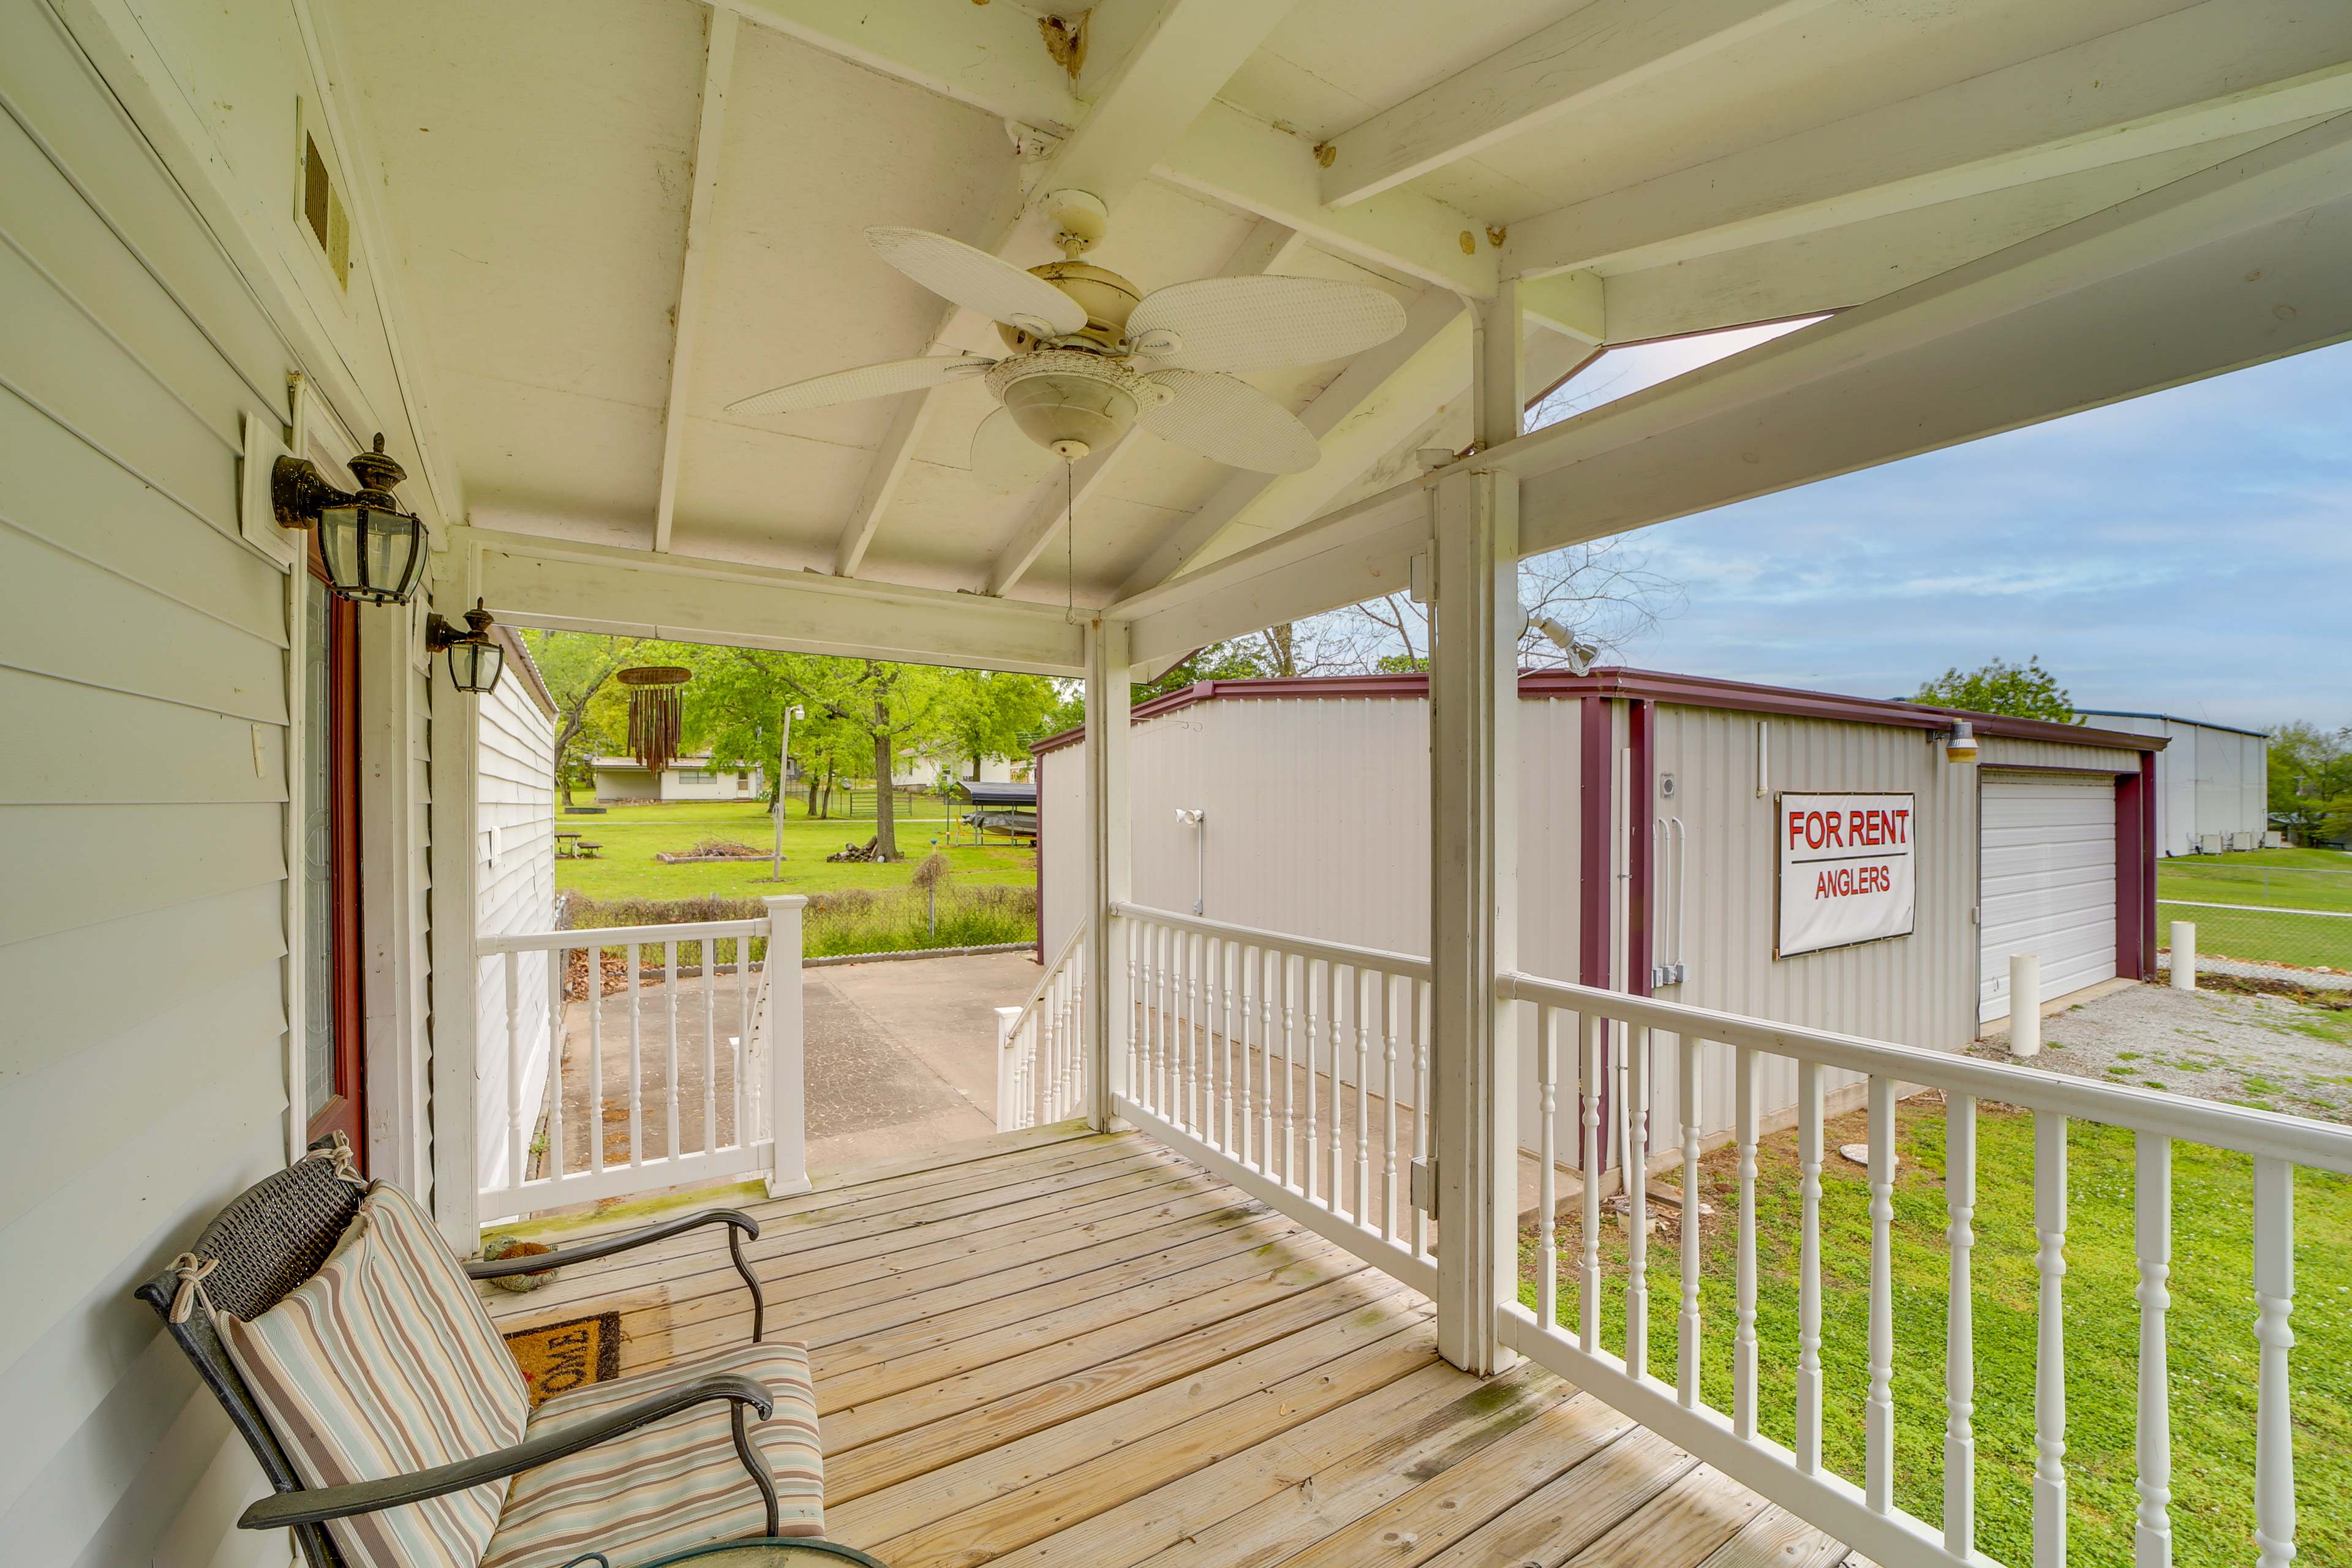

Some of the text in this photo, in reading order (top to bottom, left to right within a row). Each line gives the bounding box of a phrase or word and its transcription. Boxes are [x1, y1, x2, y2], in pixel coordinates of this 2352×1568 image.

[1789, 809, 1909, 850] FOR RENT
[1815, 865, 1891, 900] ANGLERS
[539, 1329, 589, 1403] OME
